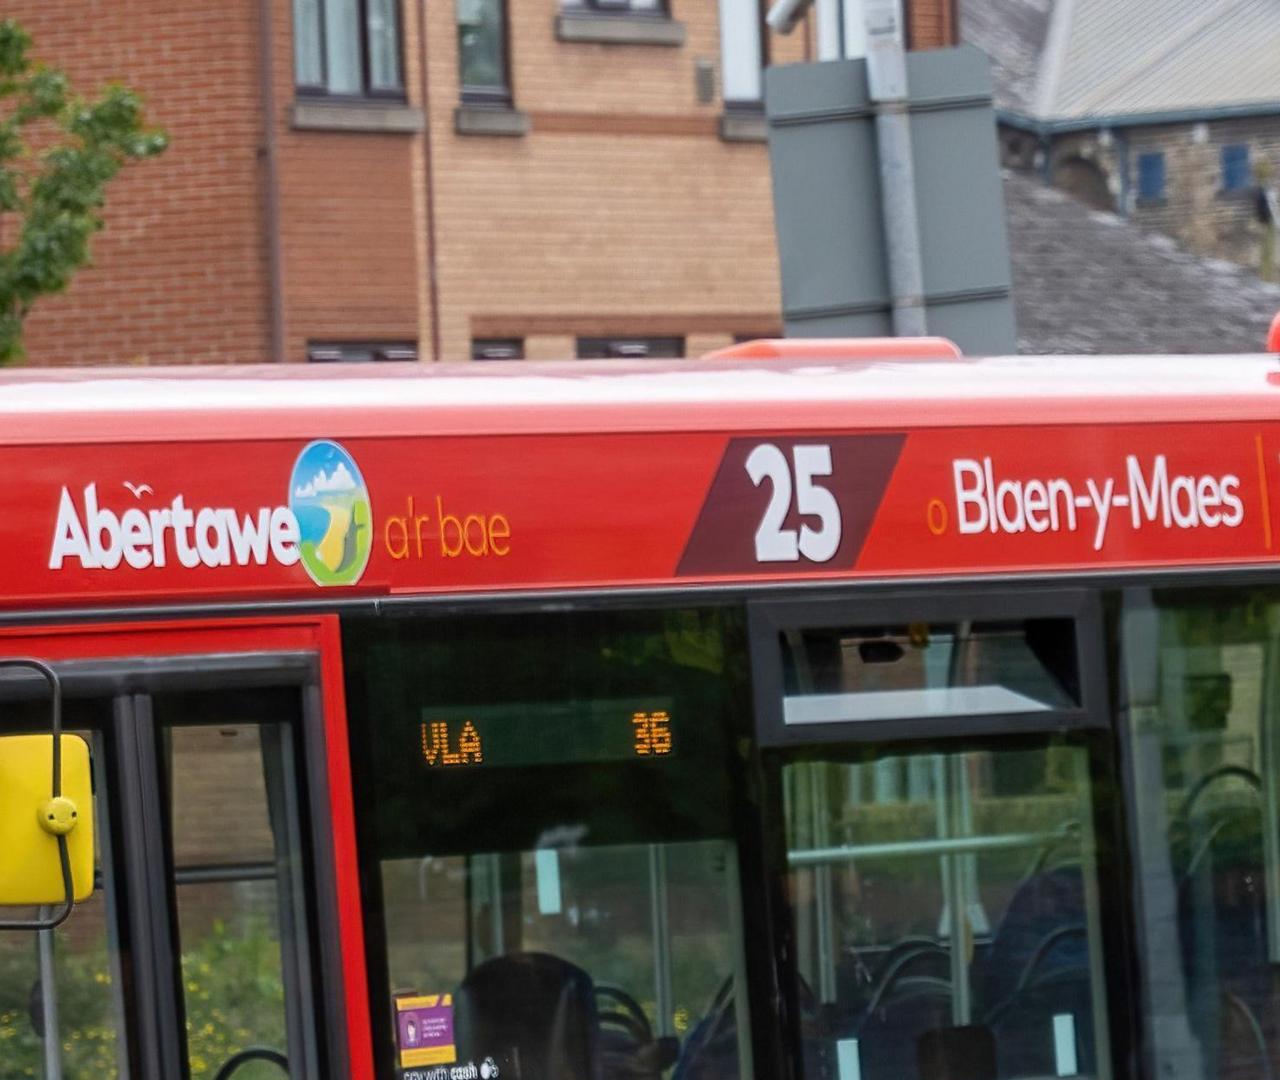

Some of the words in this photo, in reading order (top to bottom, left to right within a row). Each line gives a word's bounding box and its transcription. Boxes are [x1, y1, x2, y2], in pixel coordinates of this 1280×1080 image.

[48, 482, 301, 569] Abertawe
[436, 495, 511, 558] bae
[744, 443, 842, 562] 25
[953, 454, 1244, 550] Blaen-y-Maes
[632, 711, 671, 754] 36
[451, 1062, 477, 1080] cash
